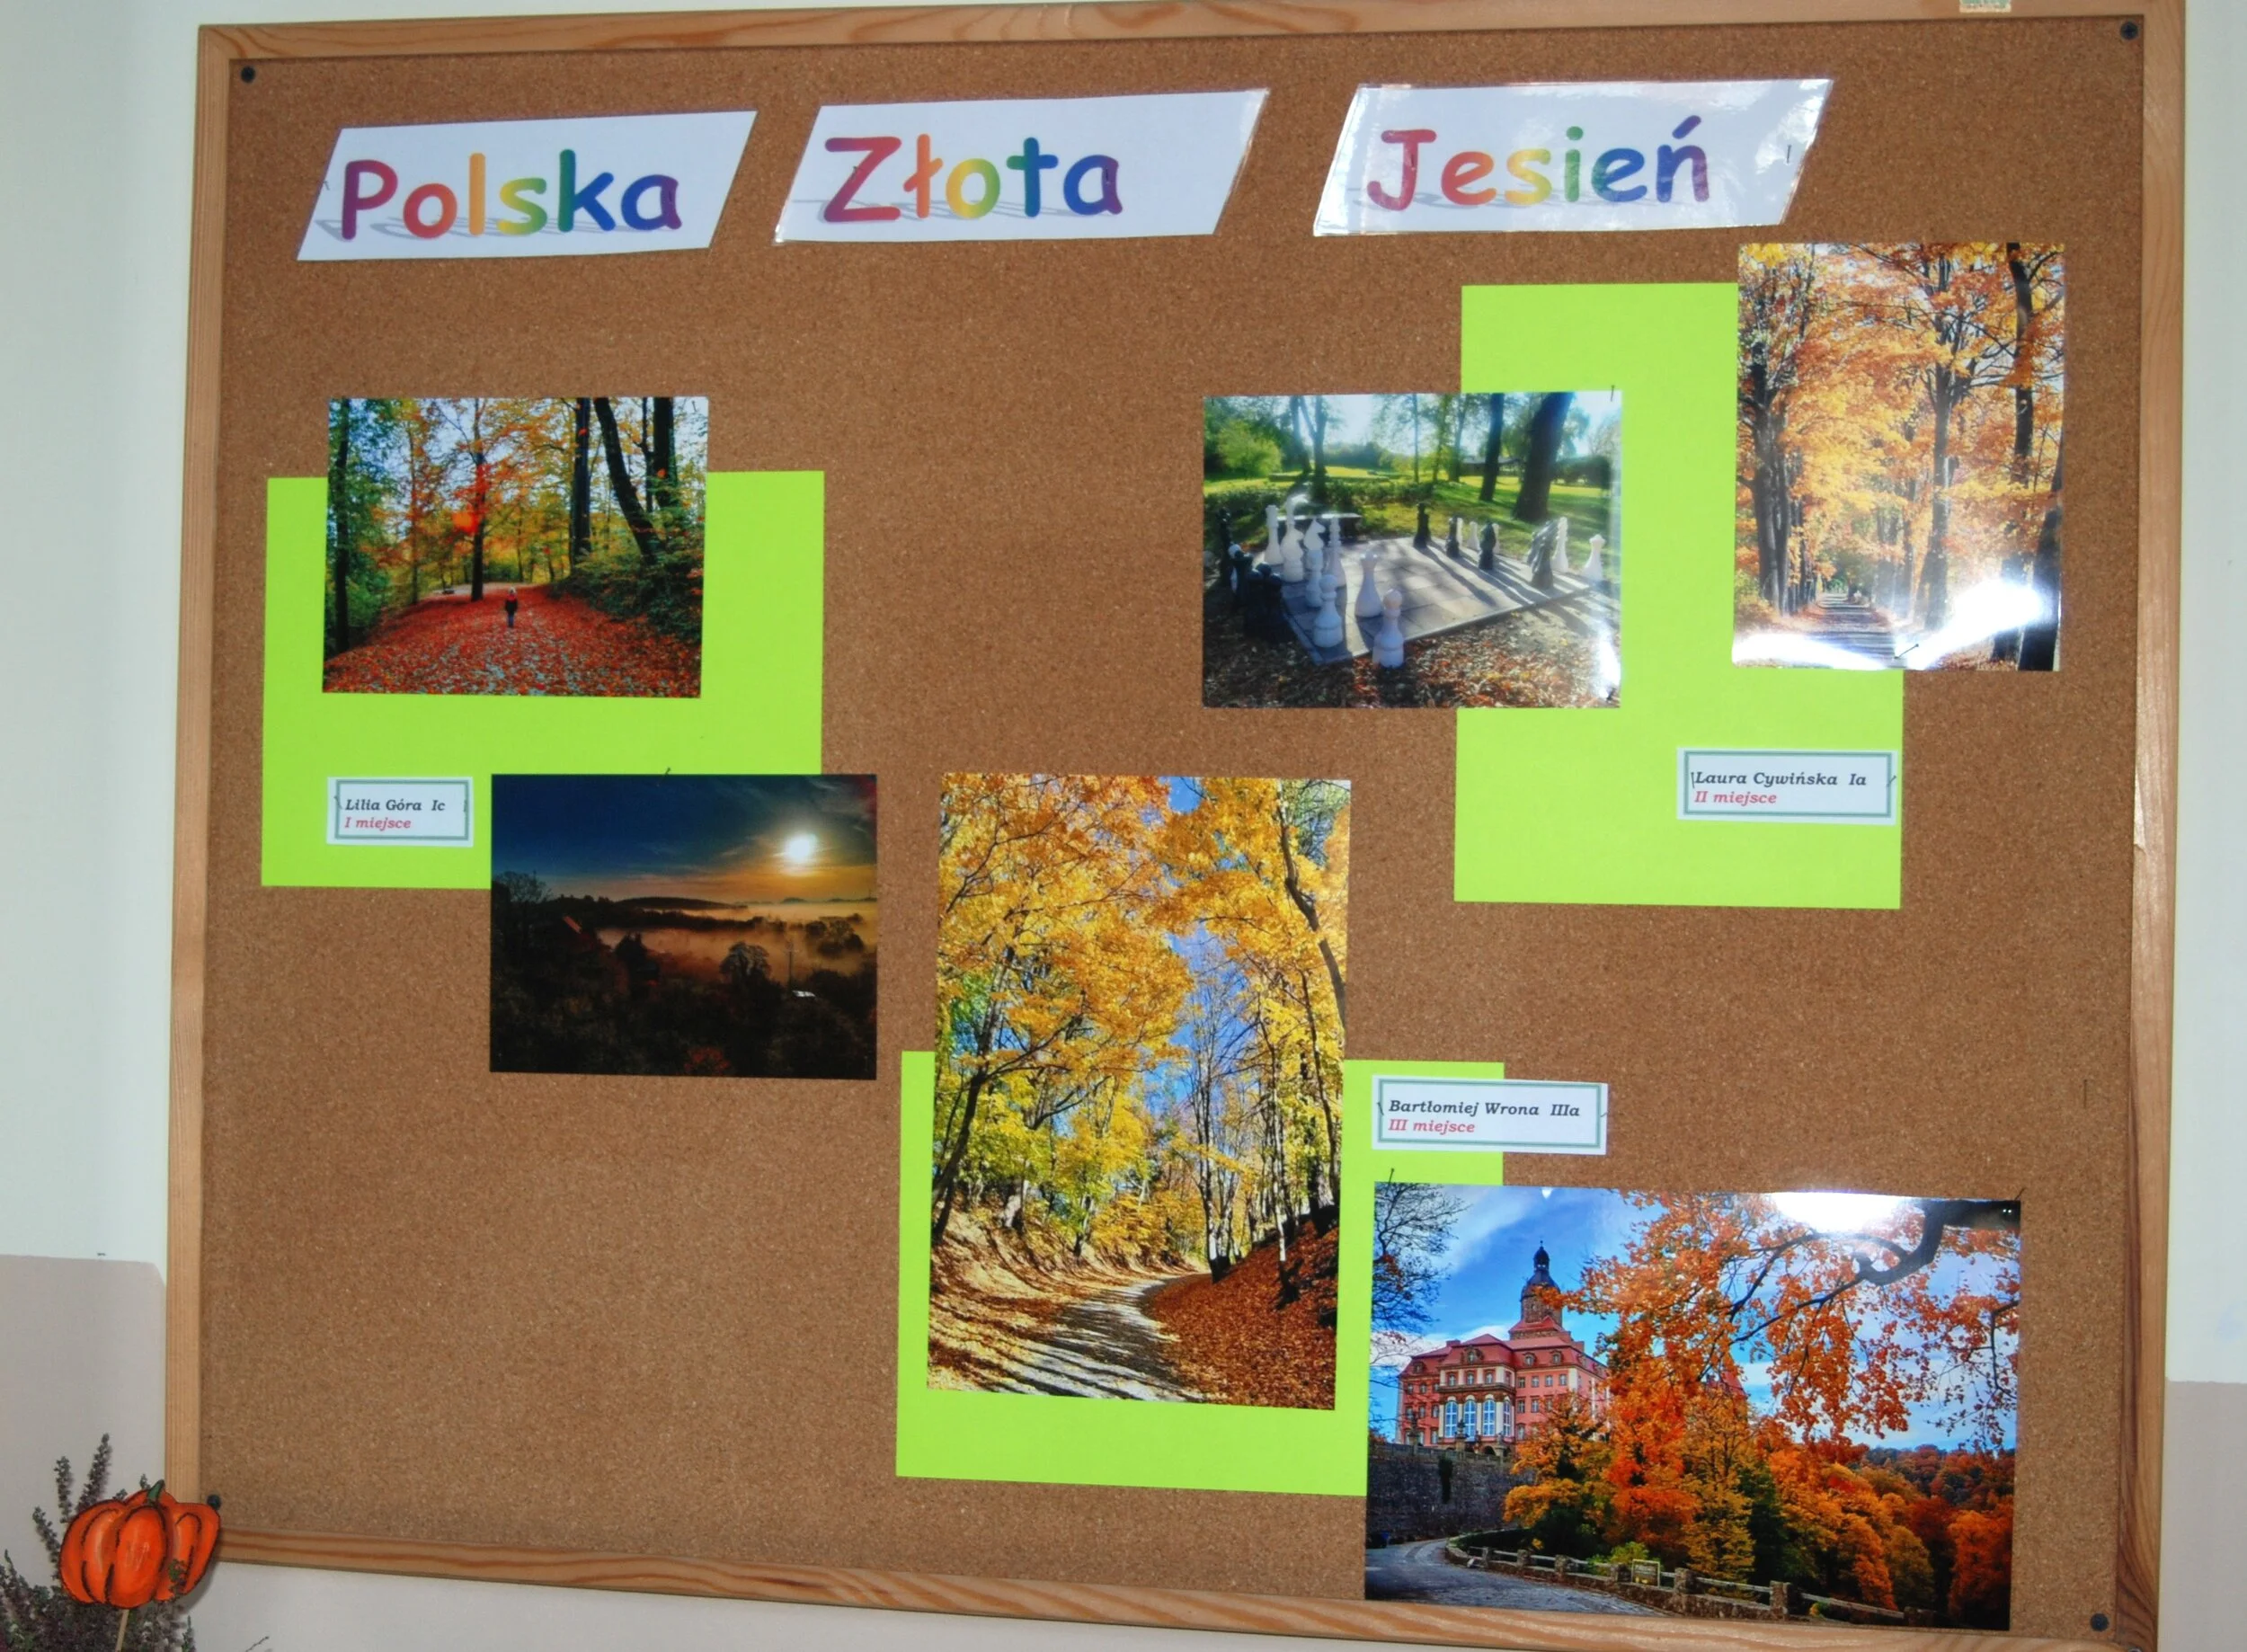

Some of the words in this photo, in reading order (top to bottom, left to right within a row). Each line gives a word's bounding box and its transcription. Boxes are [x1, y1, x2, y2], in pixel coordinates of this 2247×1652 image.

[1366, 115, 1710, 211] Jesień
[823, 133, 1124, 223] Złota
[341, 148, 682, 241] Polska
[1695, 771, 1747, 785] Laura
[1754, 771, 1838, 788] Cywińska
[1849, 773, 1867, 786] Ia
[345, 799, 380, 811] Lilia
[386, 799, 422, 811] Góra
[431, 800, 446, 811] Ic
[1694, 791, 1708, 803] II
[1713, 791, 1777, 806] miejsce
[344, 817, 351, 828] I
[356, 817, 412, 831] miejsce
[1389, 1099, 1479, 1117] Bartłomiej
[1485, 1102, 1541, 1116] Wrona
[1550, 1104, 1581, 1117] IIIa
[1388, 1119, 1408, 1132] III
[1413, 1120, 1475, 1135] miejsce
